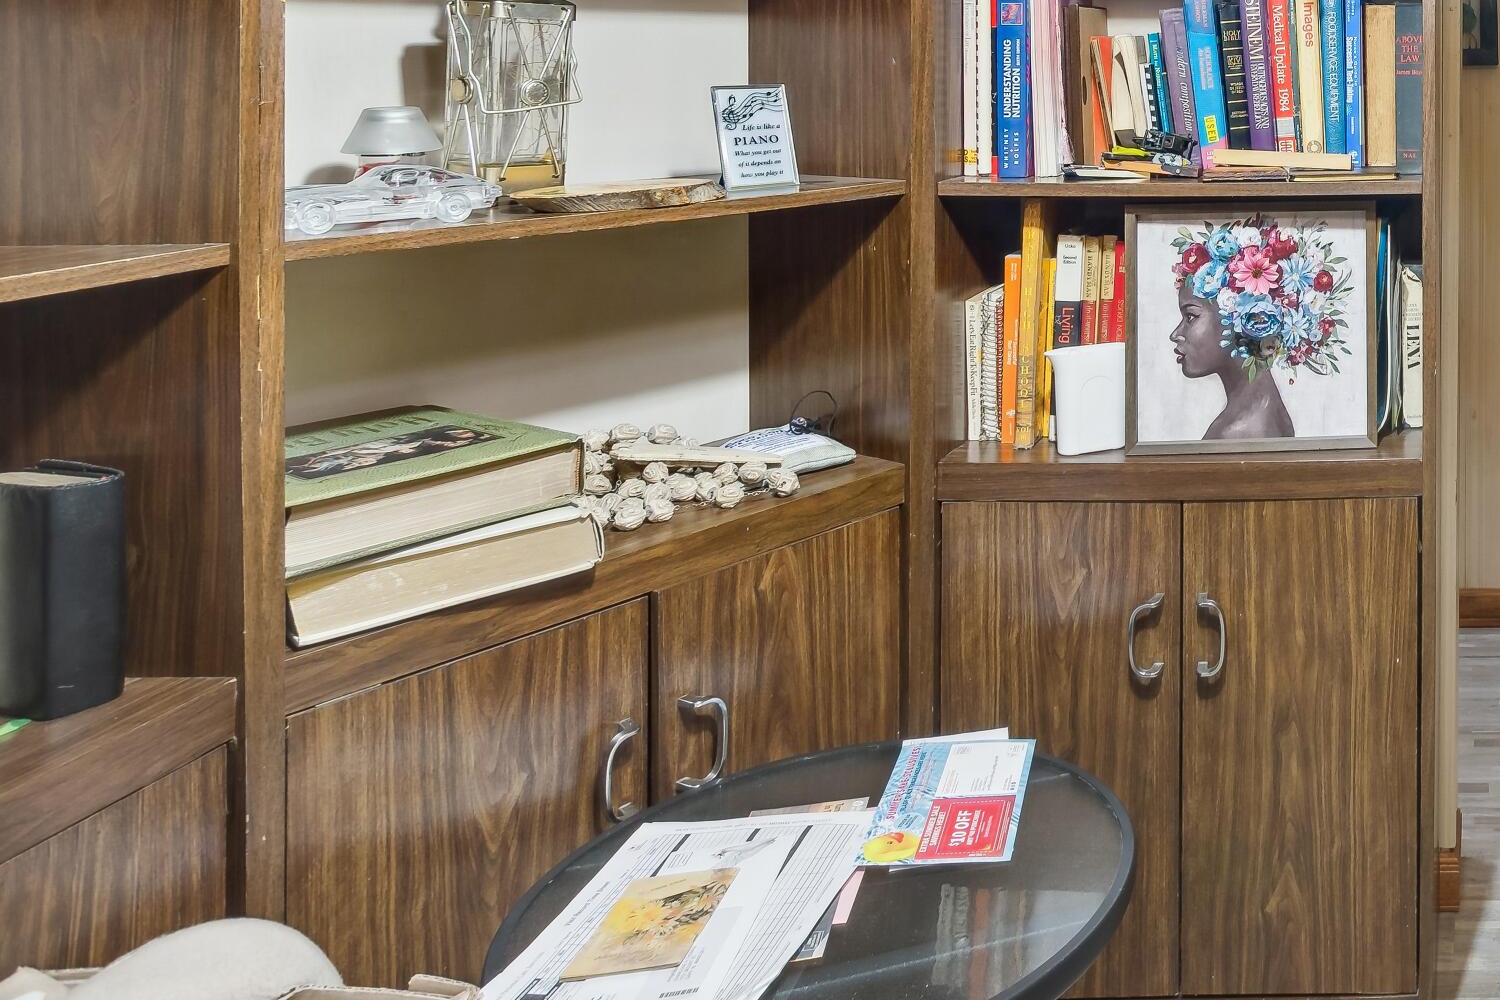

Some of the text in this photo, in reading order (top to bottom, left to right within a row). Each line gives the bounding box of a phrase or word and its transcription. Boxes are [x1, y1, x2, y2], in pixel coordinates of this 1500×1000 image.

[1302, 1, 1315, 47] Images
[1328, 11, 1338, 72] FOODSERVICE
[1401, 45, 1419, 53] THE
[1272, 4, 1290, 112] Medical Update 1984
[1400, 54, 1420, 63] LAW
[1003, 39, 1012, 118] UNDERSTANDING
[1346, 36, 1354, 104] Successful Test-Taking
[1012, 68, 1021, 118] NUTRITION
[1175, 47, 1194, 132] modern composition
[1329, 73, 1340, 122] EQUIPMENT
[1252, 94, 1262, 129] REBELLIONS
[1261, 115, 1270, 128] AND
[742, 123, 755, 131] Life
[1206, 117, 1217, 142] USED
[734, 134, 779, 146] PIANO
[734, 149, 751, 157] What
[750, 159, 773, 167] depends
[766, 170, 778, 178] play
[1058, 307, 1075, 344] Living
[968, 345, 976, 363] Right
[970, 363, 976, 371] To
[968, 371, 977, 388] Keep
[886, 793, 902, 820] SUMMER
[954, 810, 972, 830] OFF
[948, 831, 967, 847] $10
